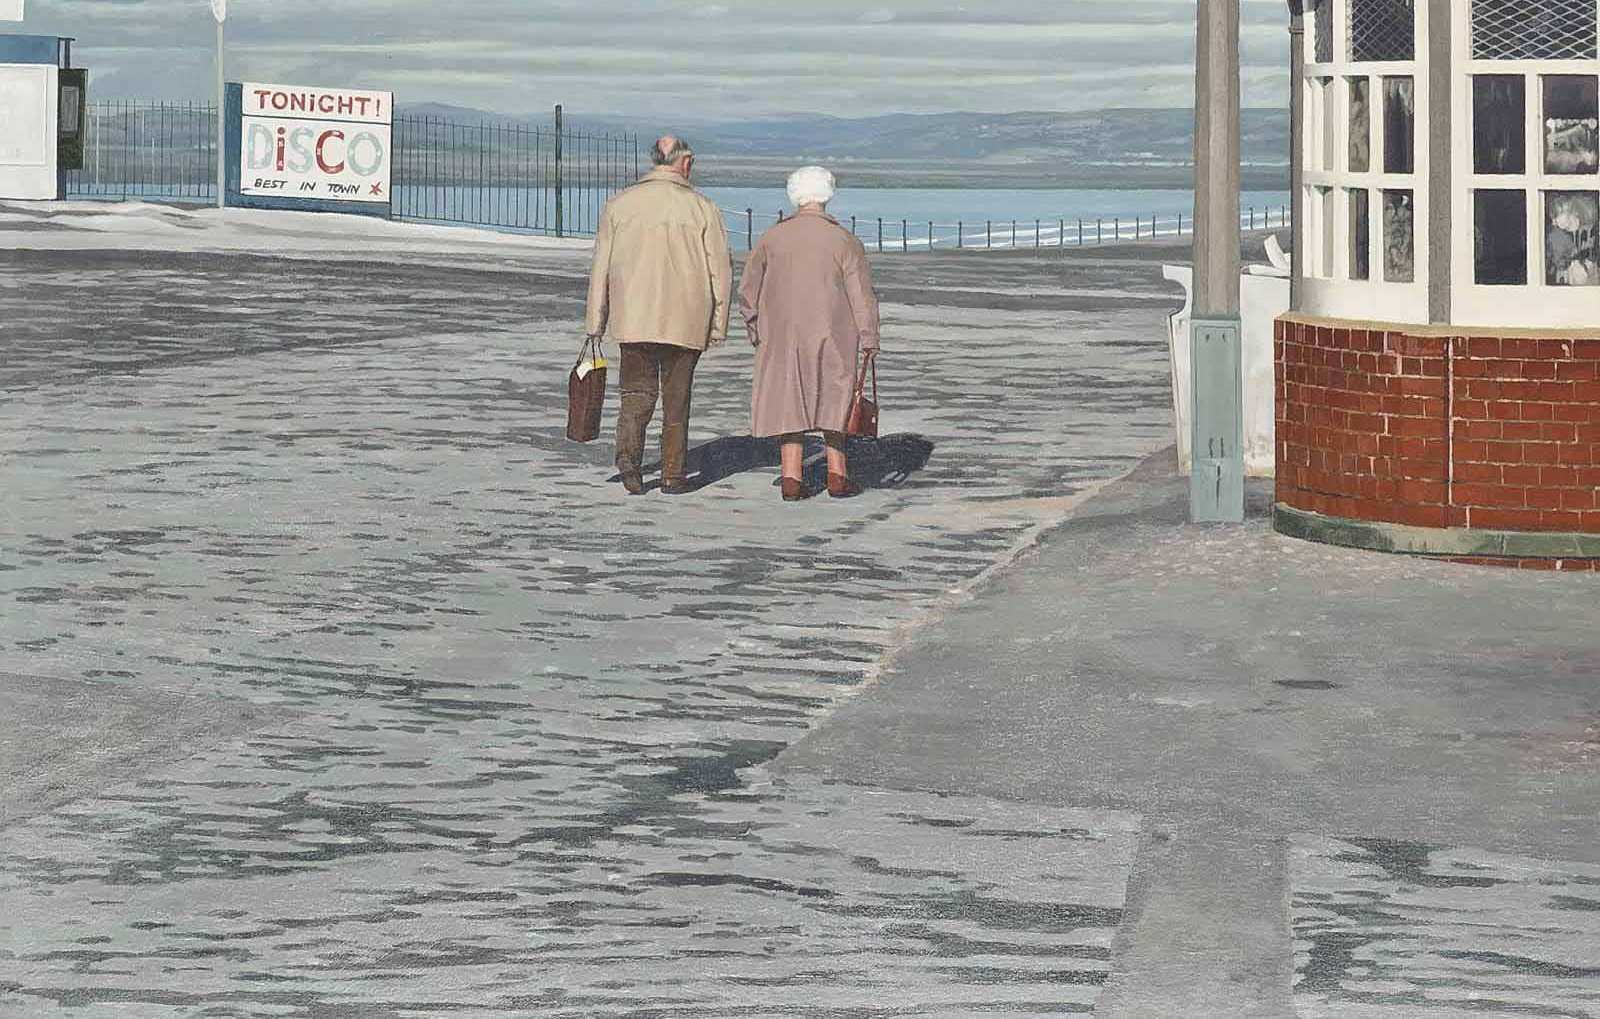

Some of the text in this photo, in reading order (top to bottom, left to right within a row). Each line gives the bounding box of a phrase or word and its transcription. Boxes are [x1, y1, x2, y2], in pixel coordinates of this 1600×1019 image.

[254, 178, 361, 194] BEST IN TOWN
